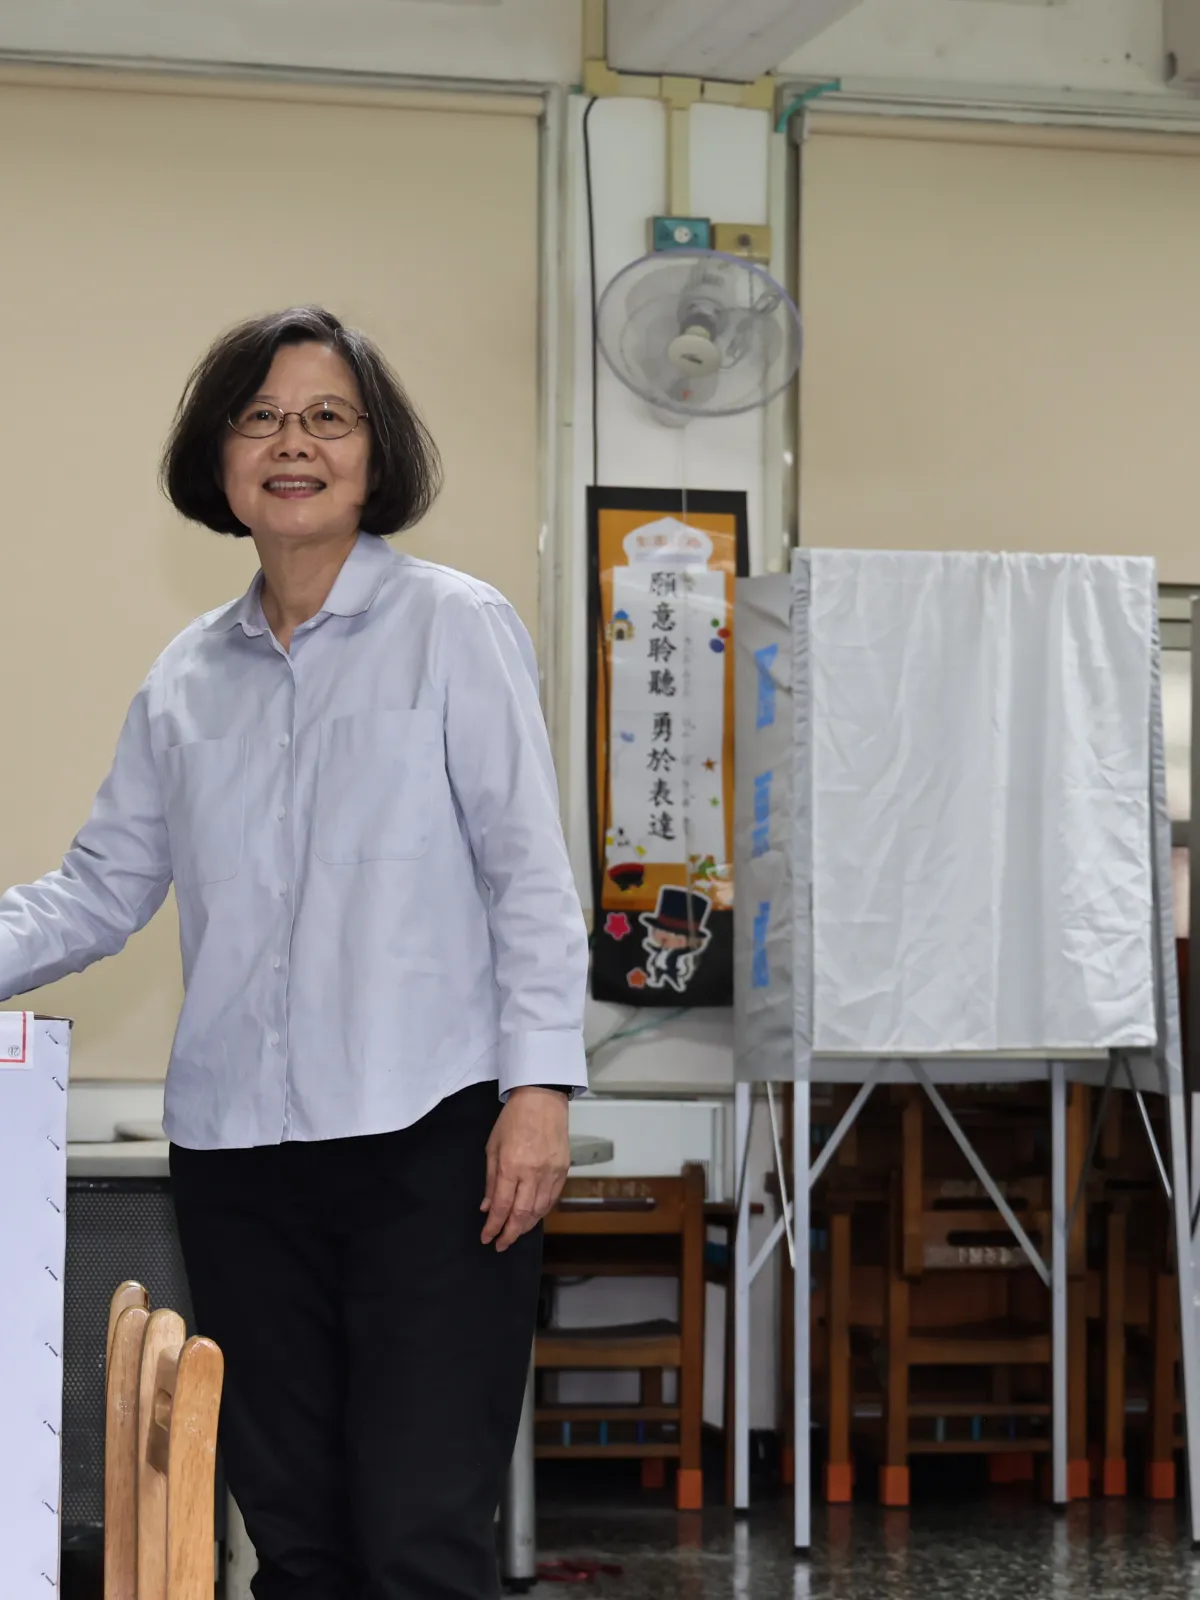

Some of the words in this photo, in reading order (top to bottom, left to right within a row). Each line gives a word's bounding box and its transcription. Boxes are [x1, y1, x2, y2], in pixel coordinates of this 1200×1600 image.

[647, 571, 677, 697] 願意聆聽
[647, 712, 677, 840] 勇於表達
